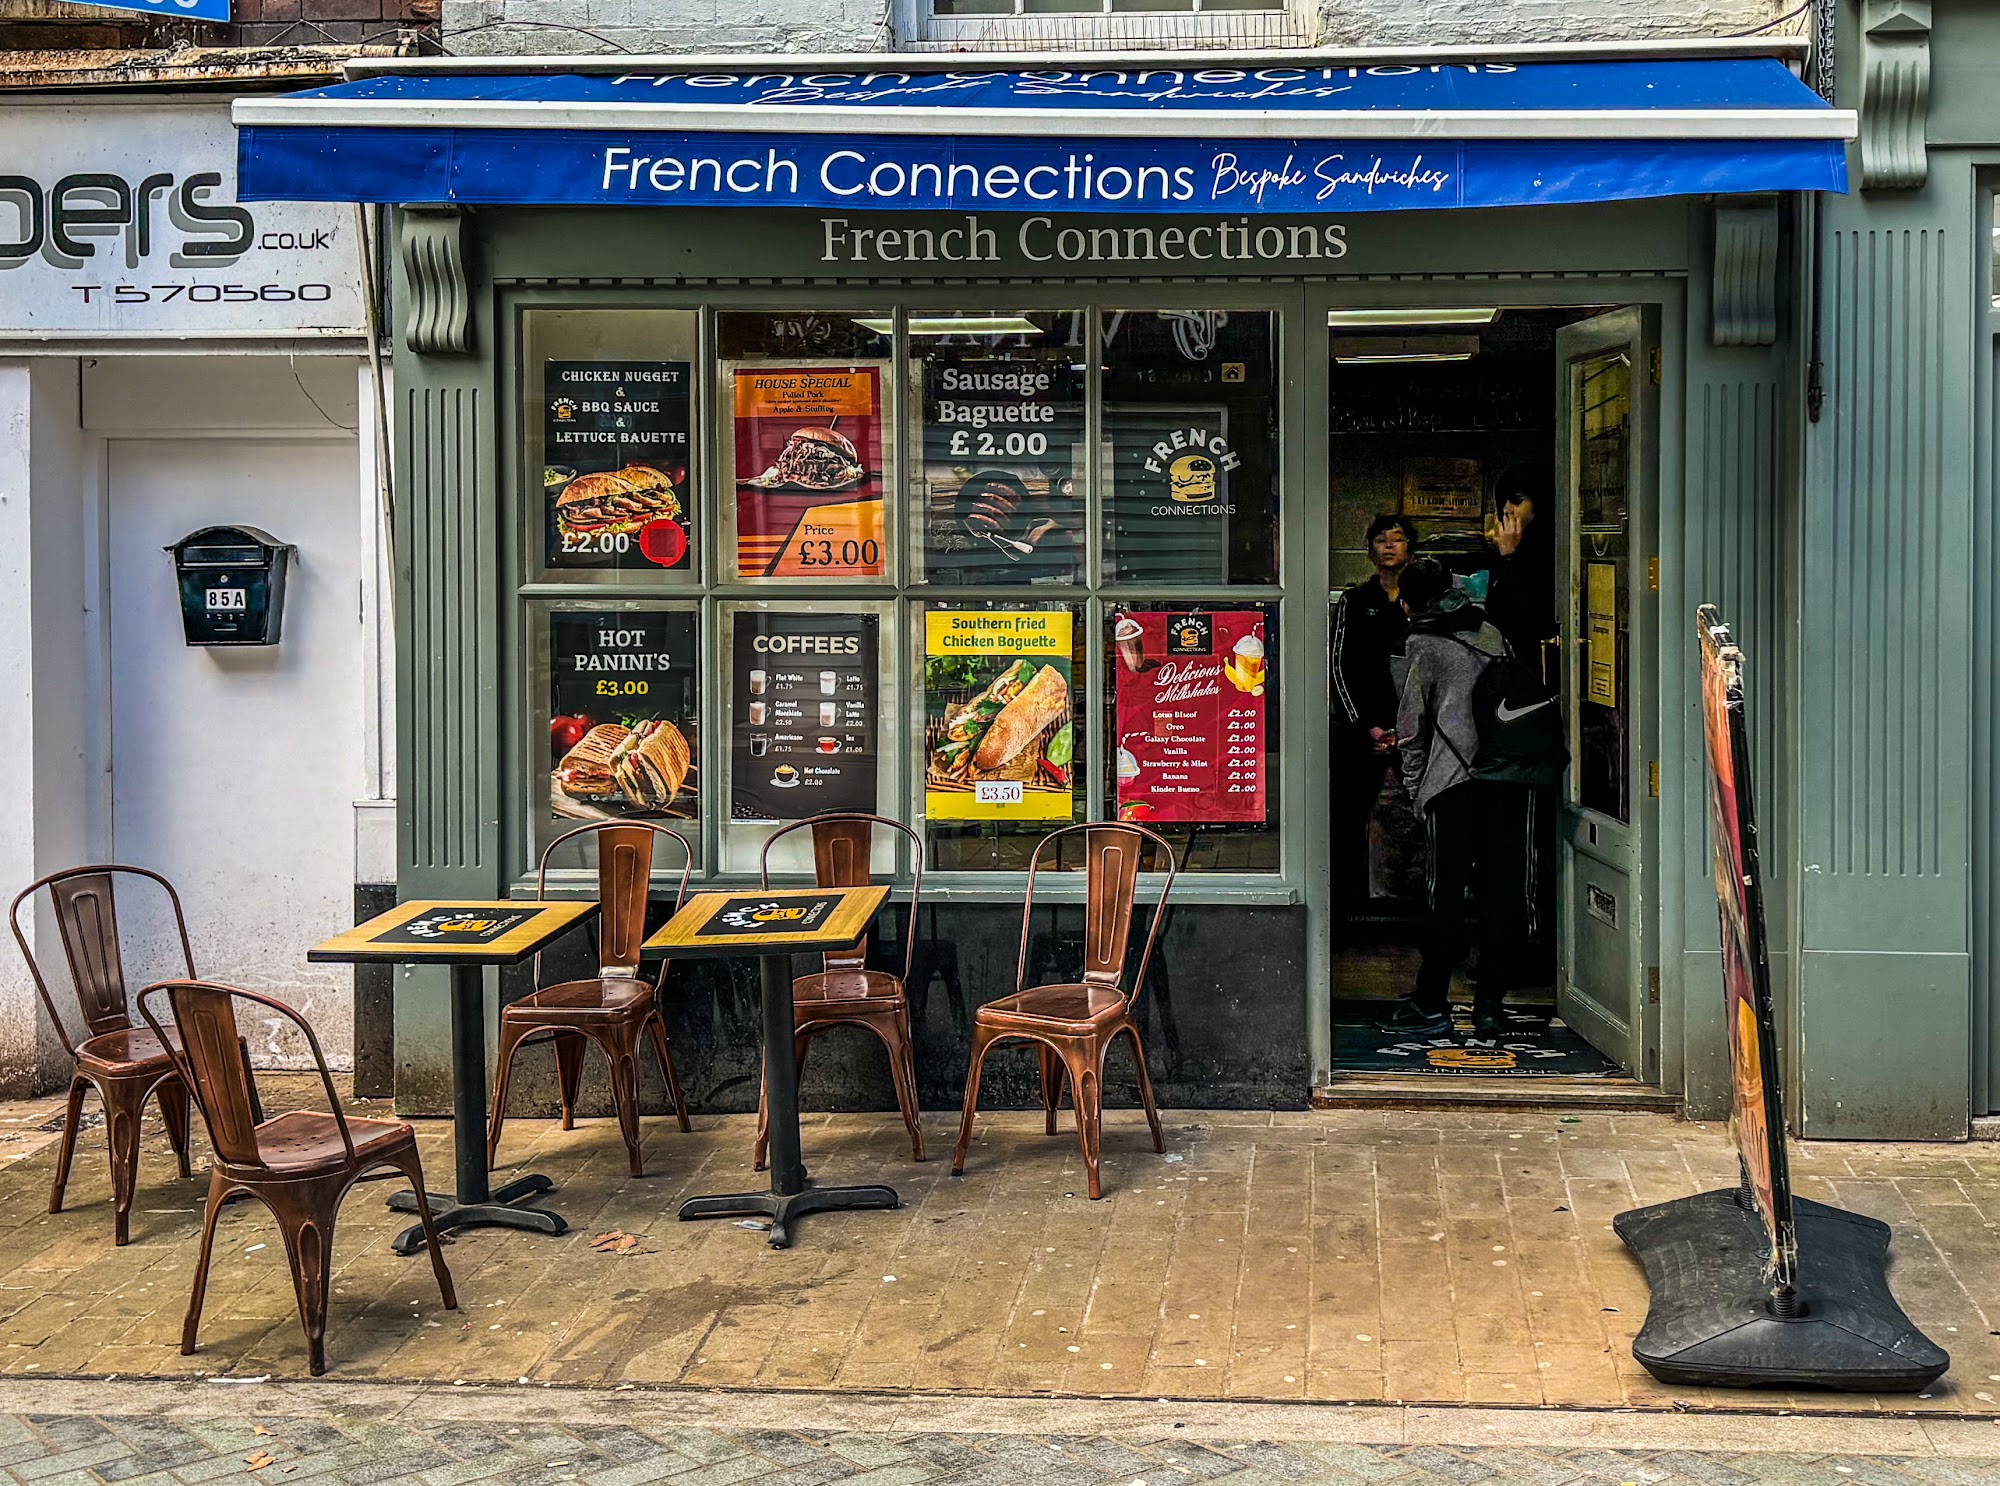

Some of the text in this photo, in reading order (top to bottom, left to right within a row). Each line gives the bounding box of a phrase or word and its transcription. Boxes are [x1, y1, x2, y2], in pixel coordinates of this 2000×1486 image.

[602, 147, 1449, 203] French Connections Bespoke Sandwiches
[820, 216, 1348, 262] French Connections
[71, 283, 332, 304] T 570560
[561, 371, 679, 382] CHICKEN NUGGET
[942, 368, 1050, 396] Sausage
[754, 377, 852, 389] HOUSE SPECIAL
[615, 386, 626, 397] &
[782, 390, 825, 399] Pulled Pork
[581, 402, 660, 413] BBQ SAUCE
[773, 406, 794, 414] Apple
[938, 400, 1055, 429] Baguette
[615, 417, 626, 428] &
[556, 431, 686, 443] LETTUCE BAUETTE
[1143, 427, 1241, 474] FRENCH
[1150, 504, 1236, 516] CONNECTIONS
[804, 524, 834, 535] Price
[561, 532, 630, 553] £2.00
[798, 539, 879, 566] £3.00
[208, 591, 244, 607] 85A
[952, 617, 1046, 633] Southern fried
[1170, 617, 1209, 636] FRENCH
[598, 630, 646, 647] HOT
[942, 635, 1056, 651] Chicken Baguette
[752, 635, 859, 654] COFFEES
[574, 653, 671, 671] PANINI'S
[788, 674, 803, 682] White
[1154, 660, 1223, 686] Delicious
[596, 679, 649, 697] £3.00
[1154, 679, 1222, 704] Milkshakes
[775, 701, 798, 709] Caramel
[846, 701, 865, 709] Vanilla
[1227, 709, 1256, 718] £2.00
[1166, 723, 1185, 731] Oreo
[1227, 721, 1256, 730] £2.00
[1144, 735, 1206, 744] Galaxy Chocolate
[1227, 733, 1256, 743] £2.00
[1163, 747, 1188, 755] Vanilla
[1227, 745, 1256, 754] £2.00
[1142, 759, 1180, 768] Strawberry
[1190, 759, 1208, 768] Mint
[1227, 758, 1256, 767] £2.00
[815, 767, 841, 775] Chocolate
[1162, 772, 1188, 780] Banana
[1227, 771, 1256, 780] £2.00
[981, 786, 1020, 800] £3.50
[1150, 785, 1175, 793] Kinder
[1227, 783, 1256, 793] £2.00
[1376, 1038, 1567, 1058] FRENCH
